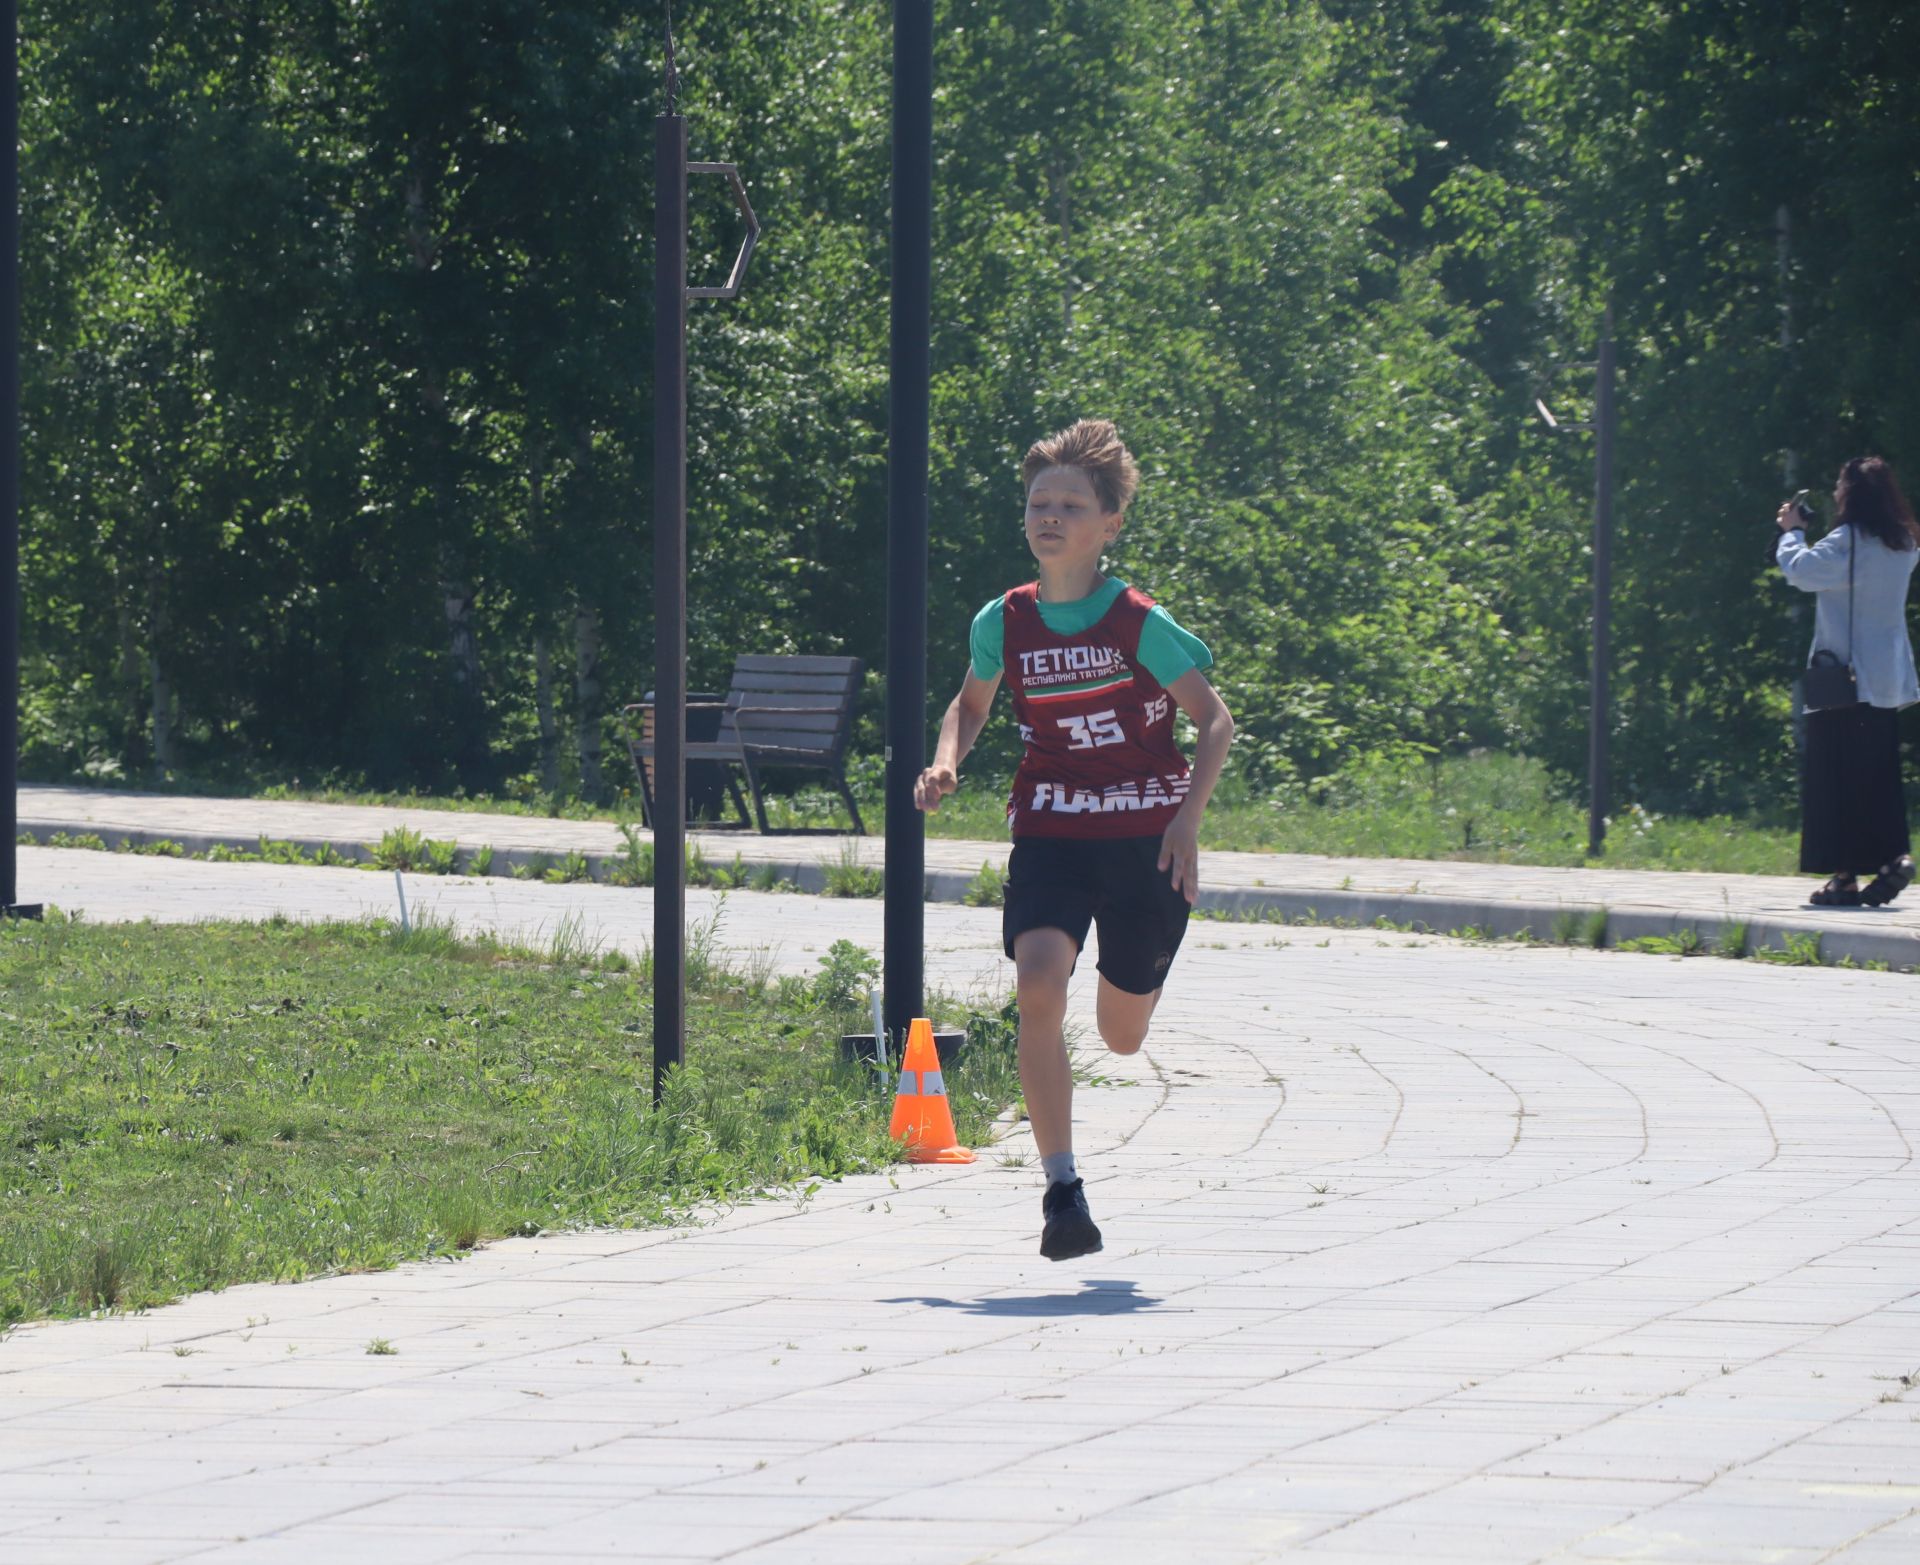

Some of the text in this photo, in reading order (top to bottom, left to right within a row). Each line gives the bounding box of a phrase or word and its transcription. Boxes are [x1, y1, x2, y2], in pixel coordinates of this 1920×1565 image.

[1022, 672, 1077, 686] РЕСПУБЛИКА
[1143, 694, 1168, 728] 35
[1056, 709, 1126, 750] 35
